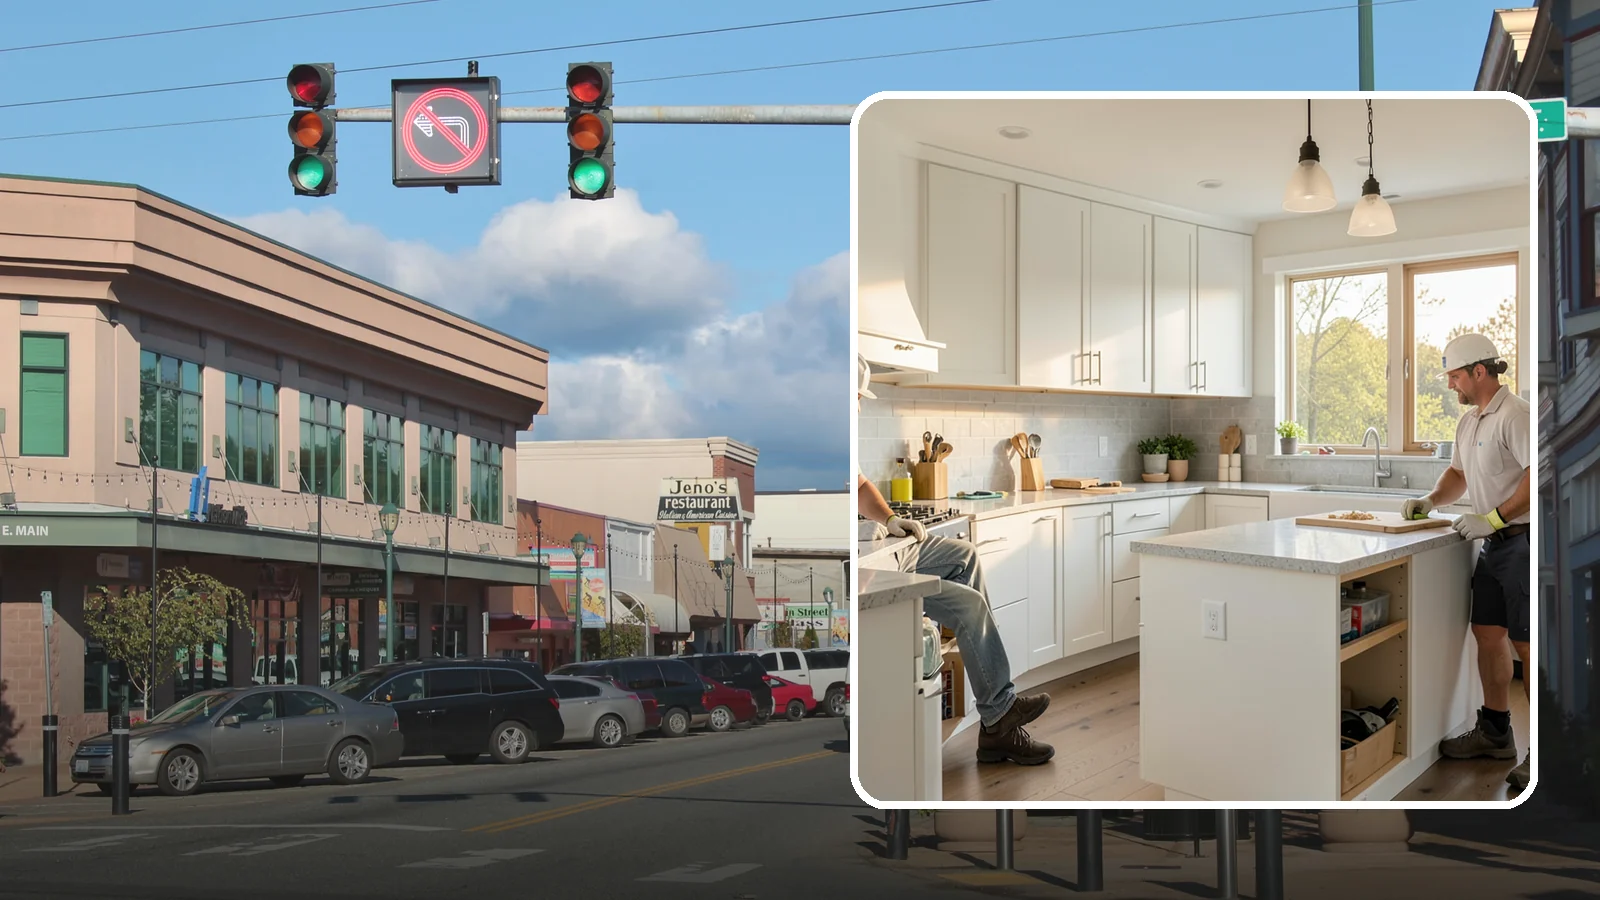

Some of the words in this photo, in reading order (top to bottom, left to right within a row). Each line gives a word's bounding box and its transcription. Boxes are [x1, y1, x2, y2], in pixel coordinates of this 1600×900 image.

[670, 480, 727, 494] Jeno's
[665, 496, 731, 509] restaurant
[658, 510, 681, 519] Italian
[686, 509, 714, 519] American
[715, 509, 738, 519] Cuisine
[2, 525, 13, 536] E.
[15, 525, 49, 536] MAIN
[798, 608, 828, 617] Street
